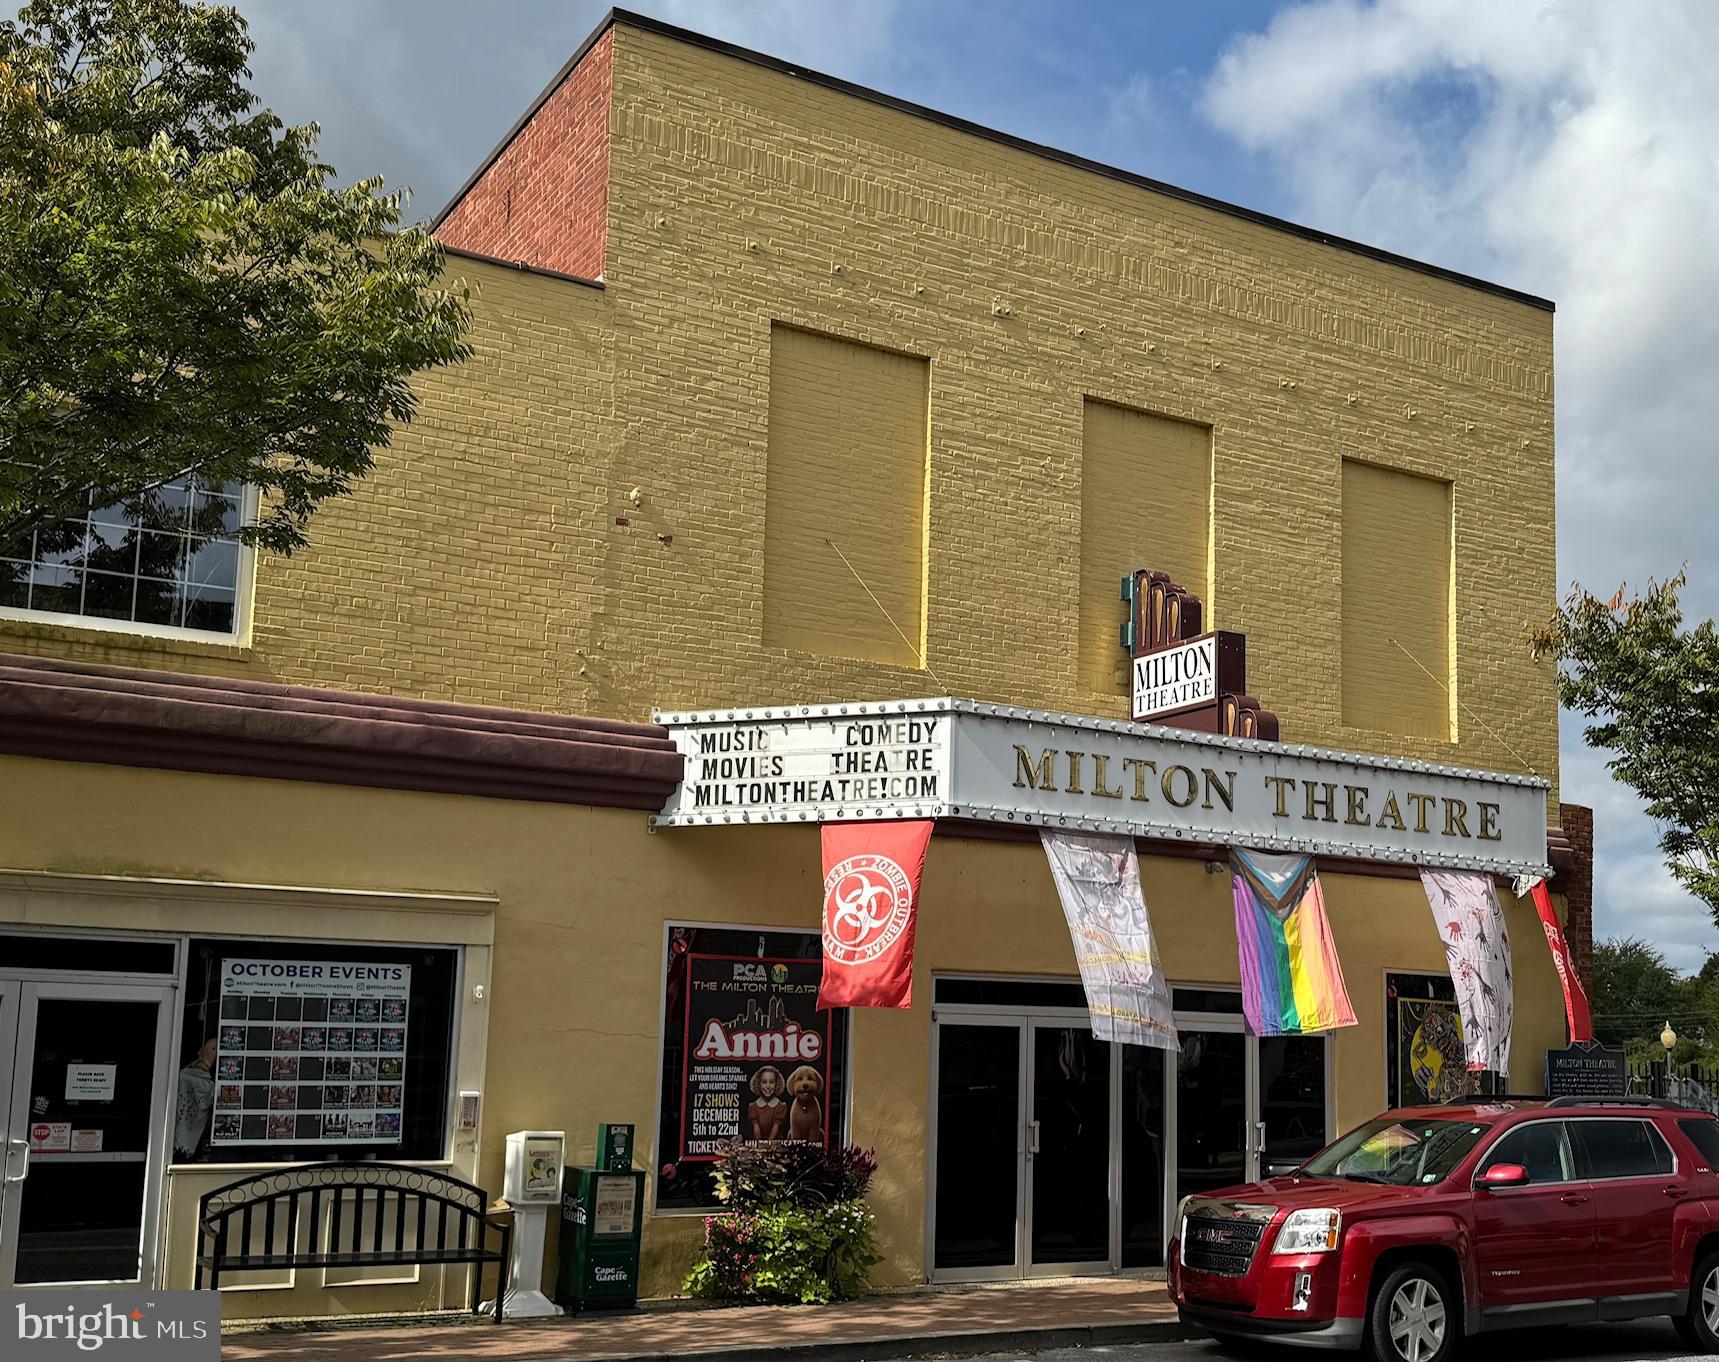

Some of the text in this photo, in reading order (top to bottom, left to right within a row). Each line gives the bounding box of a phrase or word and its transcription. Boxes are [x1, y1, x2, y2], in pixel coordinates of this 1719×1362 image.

[1136, 643, 1212, 693] MILTON
[1136, 678, 1213, 713] THEATRE
[701, 722, 937, 754] MUSIC COMEDY
[702, 749, 933, 780] MOVIES THEATRE
[1012, 744, 1502, 841] MILTON THEATRE
[865, 858, 909, 958] ZOMBIE OUTBREAK
[231, 963, 402, 980] OCTOBER EVENTS
[733, 963, 767, 977] PCA
[693, 981, 821, 994] THE MILTON THEATR
[696, 1021, 821, 1058] Annie
[1555, 1059, 1617, 1069] MILTON THEATRE
[694, 1093, 740, 1108] 17 SHOWS
[693, 1108, 740, 1122] DECEMBER
[692, 1122, 739, 1136] 5th to 22nd
[563, 1193, 578, 1208] Cape
[563, 1206, 587, 1225] Gazette
[595, 1266, 616, 1278] Cape
[596, 1273, 628, 1282] Gazette
